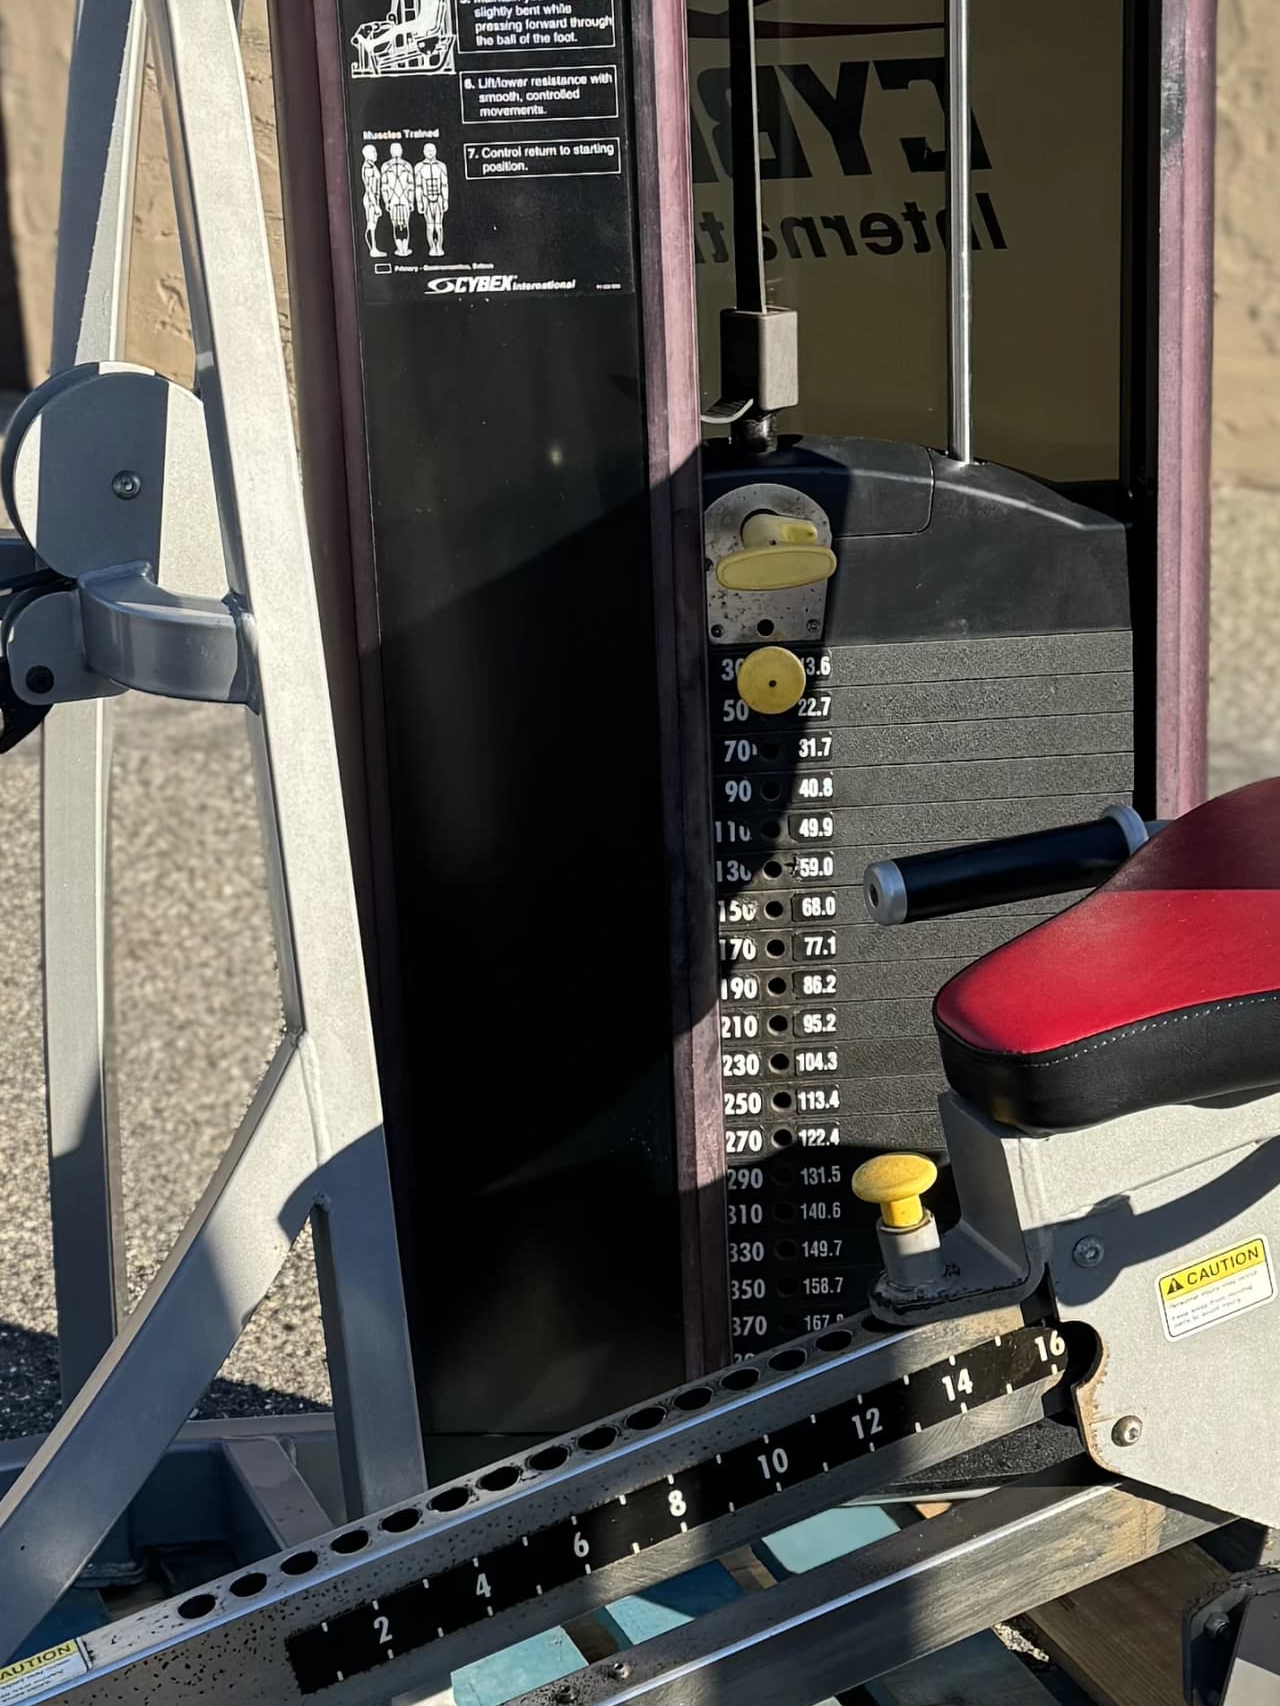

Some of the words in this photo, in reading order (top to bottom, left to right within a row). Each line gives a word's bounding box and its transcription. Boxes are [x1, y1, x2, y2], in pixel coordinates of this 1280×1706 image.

[474, 5, 513, 20] slightly
[515, 4, 541, 16] bent
[543, 3, 572, 15] while
[475, 19, 523, 34] pressing
[525, 17, 567, 30] forward
[570, 15, 612, 30] through
[476, 34, 494, 46] the
[496, 33, 517, 45] ball
[519, 32, 531, 44] of
[533, 32, 551, 44] the
[553, 31, 578, 43] foot.
[464, 78, 476, 90] 6.
[478, 76, 528, 89] Lift/lower
[530, 75, 587, 87] resistance
[590, 72, 613, 84] with
[478, 91, 523, 104] smooth,
[526, 88, 580, 101] controlled
[479, 105, 547, 118] movements.
[403, 128, 440, 140] Trained
[468, 148, 479, 159] 7.
[481, 146, 522, 159] Control
[524, 145, 557, 158] return
[560, 144, 571, 156] to
[573, 143, 615, 158] starting
[482, 161, 529, 175] position.
[454, 276, 513, 293] CYBEX
[513, 279, 576, 291] International
[723, 699, 749, 722] 50
[798, 697, 831, 716] 22.7
[724, 739, 751, 762] 70
[798, 737, 832, 758] 31.7
[725, 780, 752, 803] 90
[799, 777, 833, 798] 40.8
[799, 817, 833, 837] 49.9
[800, 856, 833, 877] 59.0
[718, 900, 757, 922] 150
[802, 896, 836, 917] 68.0
[719, 938, 757, 960] 170
[804, 936, 836, 956] 77.1
[721, 977, 758, 1000] 190
[803, 974, 837, 995] 86.2
[721, 1015, 758, 1038] 210
[803, 1013, 837, 1033] 95.2
[722, 1053, 760, 1077] 230
[796, 1051, 838, 1071] 104.3
[724, 1092, 762, 1115] 250
[798, 1090, 840, 1110] 113.4
[725, 1130, 762, 1153] 270
[798, 1128, 840, 1147] 122.4
[727, 1167, 764, 1190] 290
[800, 1165, 841, 1186] 131.5
[728, 1203, 764, 1225] 310
[800, 1201, 842, 1221] 140.6
[729, 1241, 765, 1263] 330
[801, 1239, 843, 1258] 149.7
[1187, 1246, 1259, 1285] CAUTION
[731, 1278, 766, 1300] 350
[802, 1276, 844, 1295] 158.7
[732, 1315, 768, 1337] 370
[373, 1617, 393, 1646] 2
[474, 1571, 492, 1599] 4
[573, 1529, 590, 1559] 6
[668, 1489, 687, 1518] 8
[756, 1445, 790, 1479] 10
[850, 1406, 886, 1442] 12
[939, 1365, 974, 1401] 14
[1032, 1327, 1066, 1362] 16
